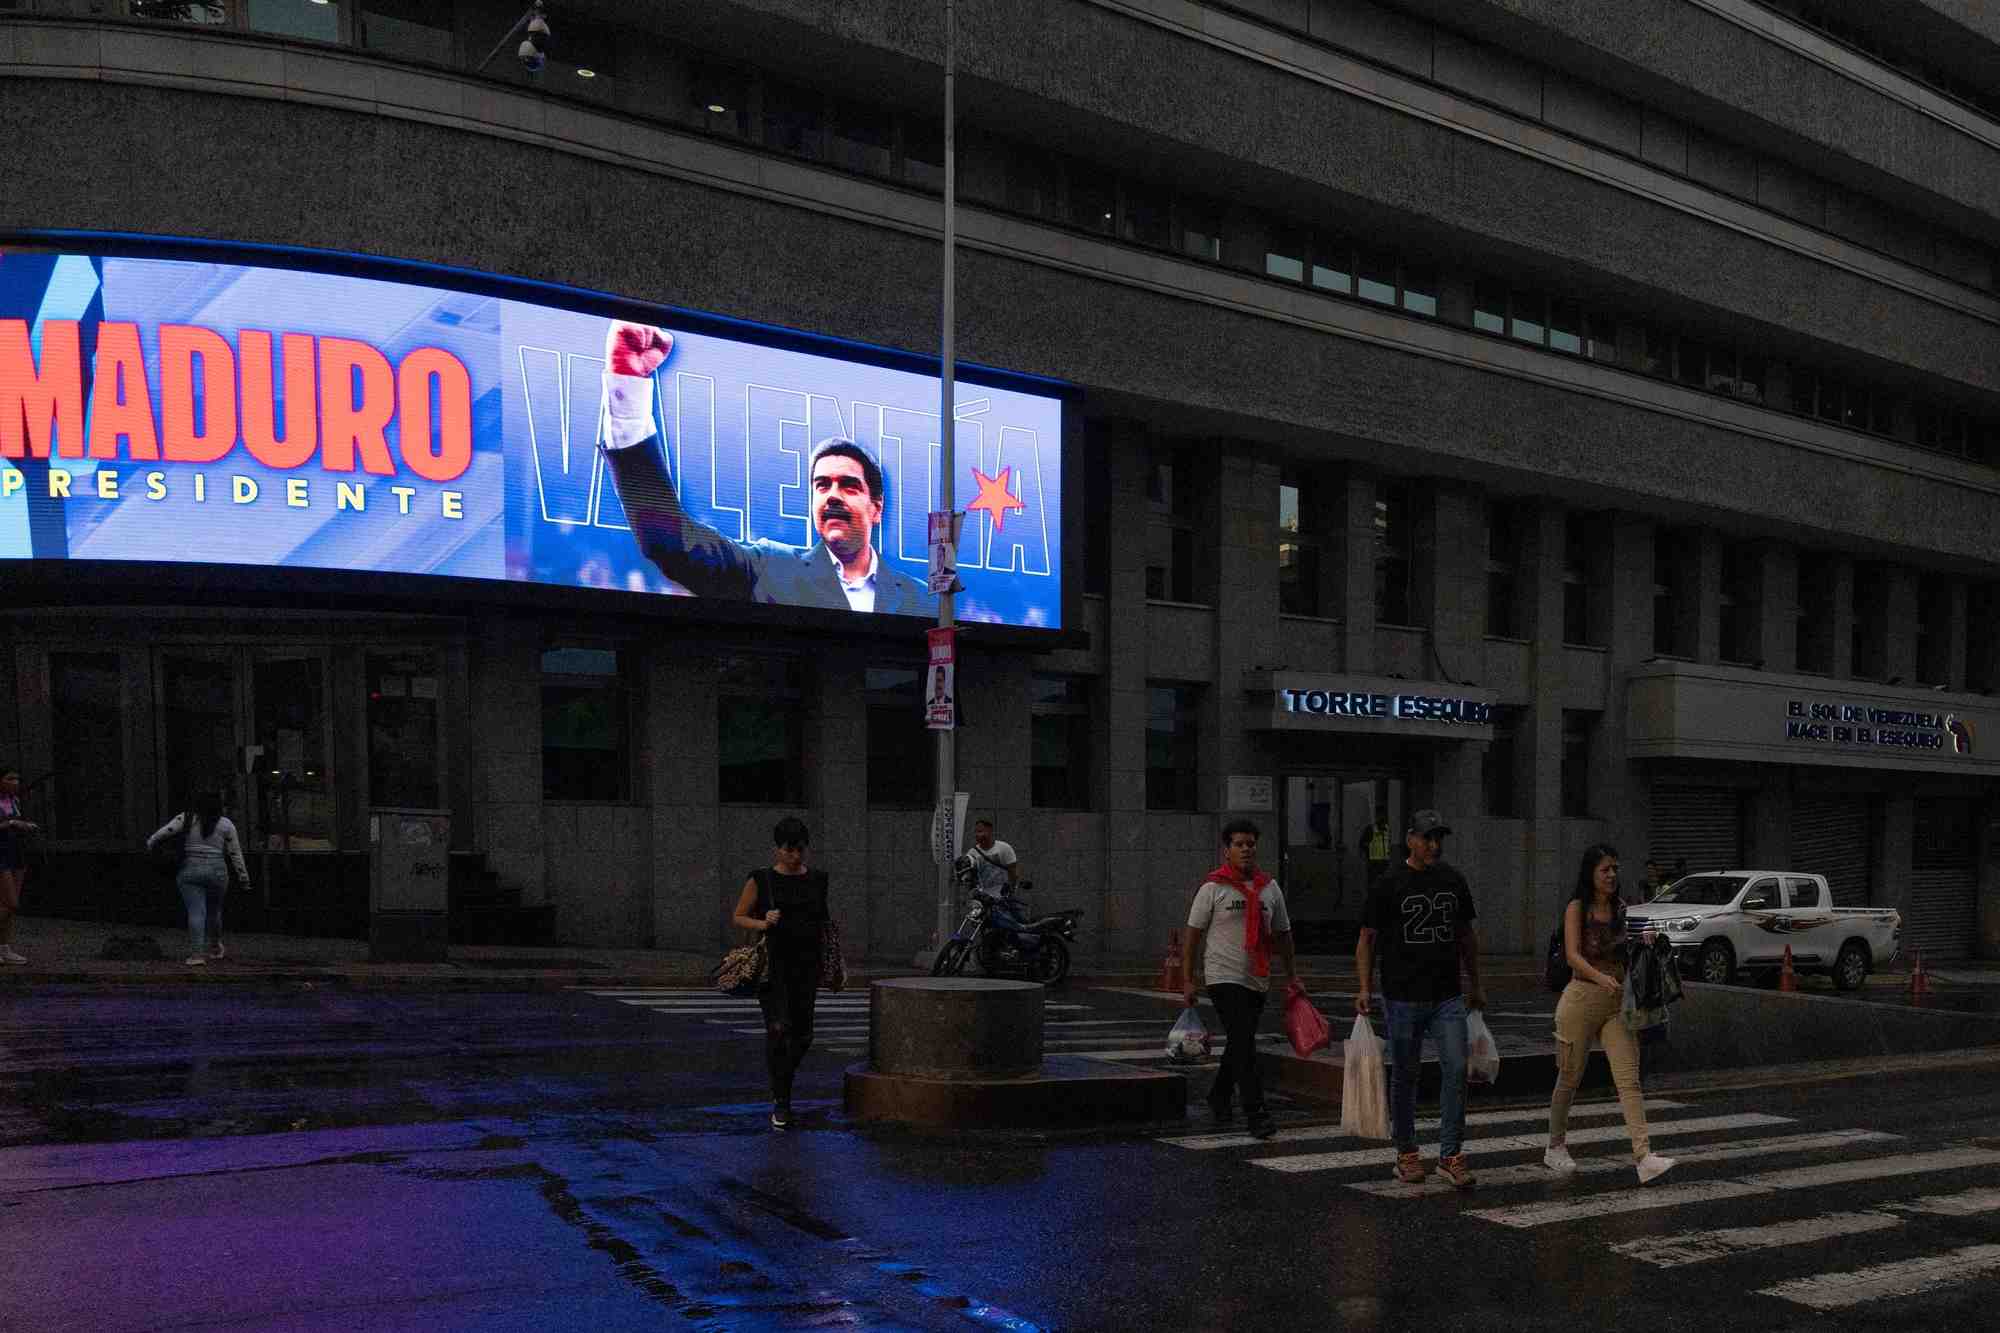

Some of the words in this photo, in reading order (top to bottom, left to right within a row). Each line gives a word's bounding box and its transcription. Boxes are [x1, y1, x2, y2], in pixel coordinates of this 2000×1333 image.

[0, 319, 472, 482] MADURO
[1, 468, 465, 520] PRESIDENTE
[1286, 689, 1385, 717] TORRE
[1787, 701, 1806, 717] EL
[1809, 703, 1838, 720] SOL
[1841, 704, 1863, 721] DE
[1865, 706, 1944, 729] VENEZUELA
[1786, 720, 1828, 738] NACE
[1832, 726, 1852, 742] EN
[1855, 727, 1874, 744] EL
[1876, 731, 1943, 748] ESEQUIBO
[1400, 891, 1460, 944] 23
